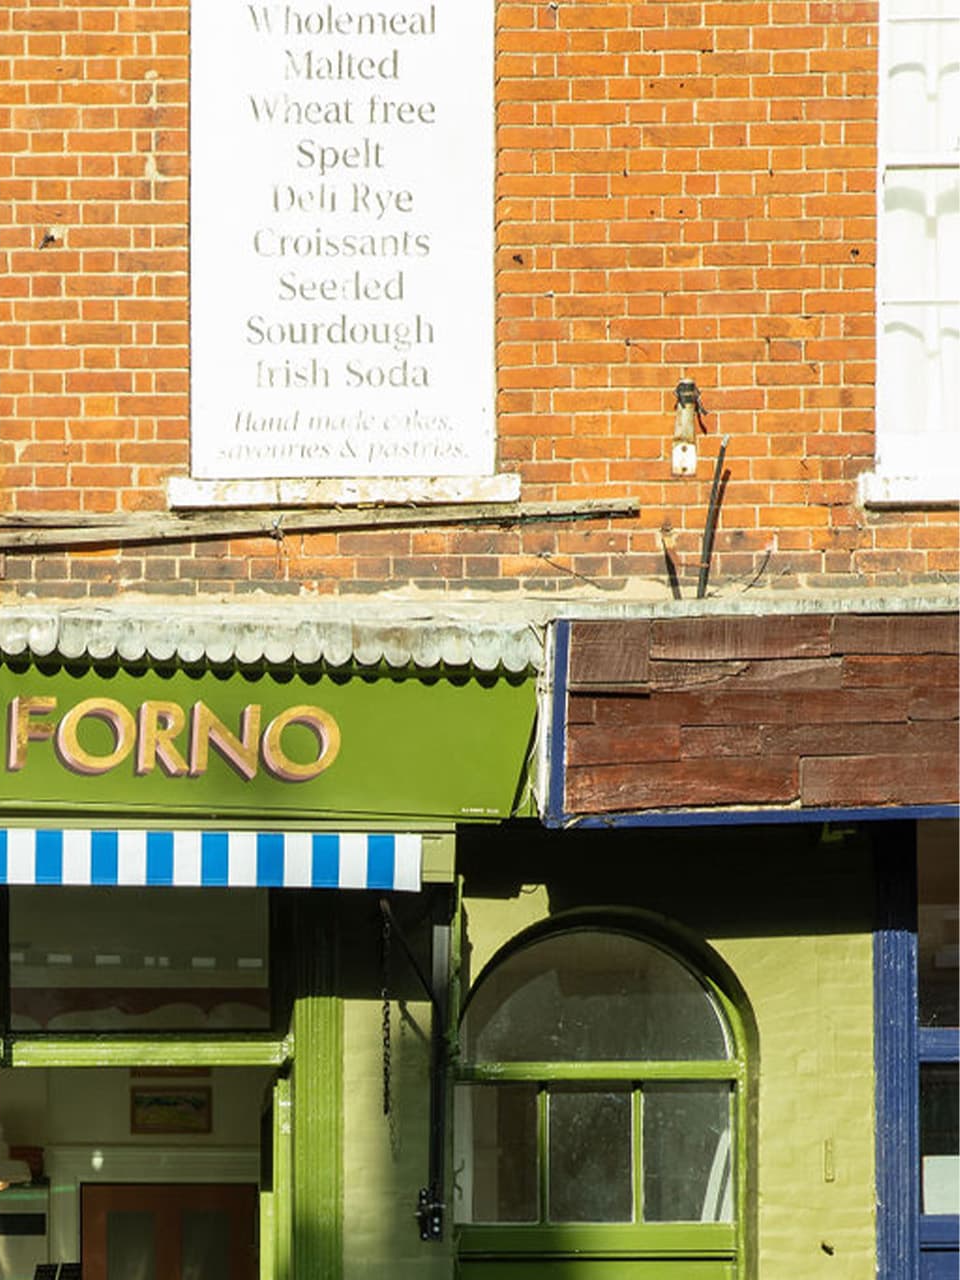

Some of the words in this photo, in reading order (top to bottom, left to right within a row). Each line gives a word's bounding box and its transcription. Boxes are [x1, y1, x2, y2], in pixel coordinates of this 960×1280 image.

[247, 4, 437, 36] Wholemeal
[283, 48, 400, 81] Malted
[248, 93, 355, 125] Wheat
[368, 94, 437, 125] free
[296, 137, 385, 177] Spelt
[351, 181, 415, 221] Rye
[253, 227, 431, 258] Croissants
[278, 270, 405, 301] Seeded
[246, 313, 436, 351] Sourdough
[256, 358, 330, 389] Irish
[345, 359, 430, 388] Soda
[6, 694, 342, 783] FORNO
